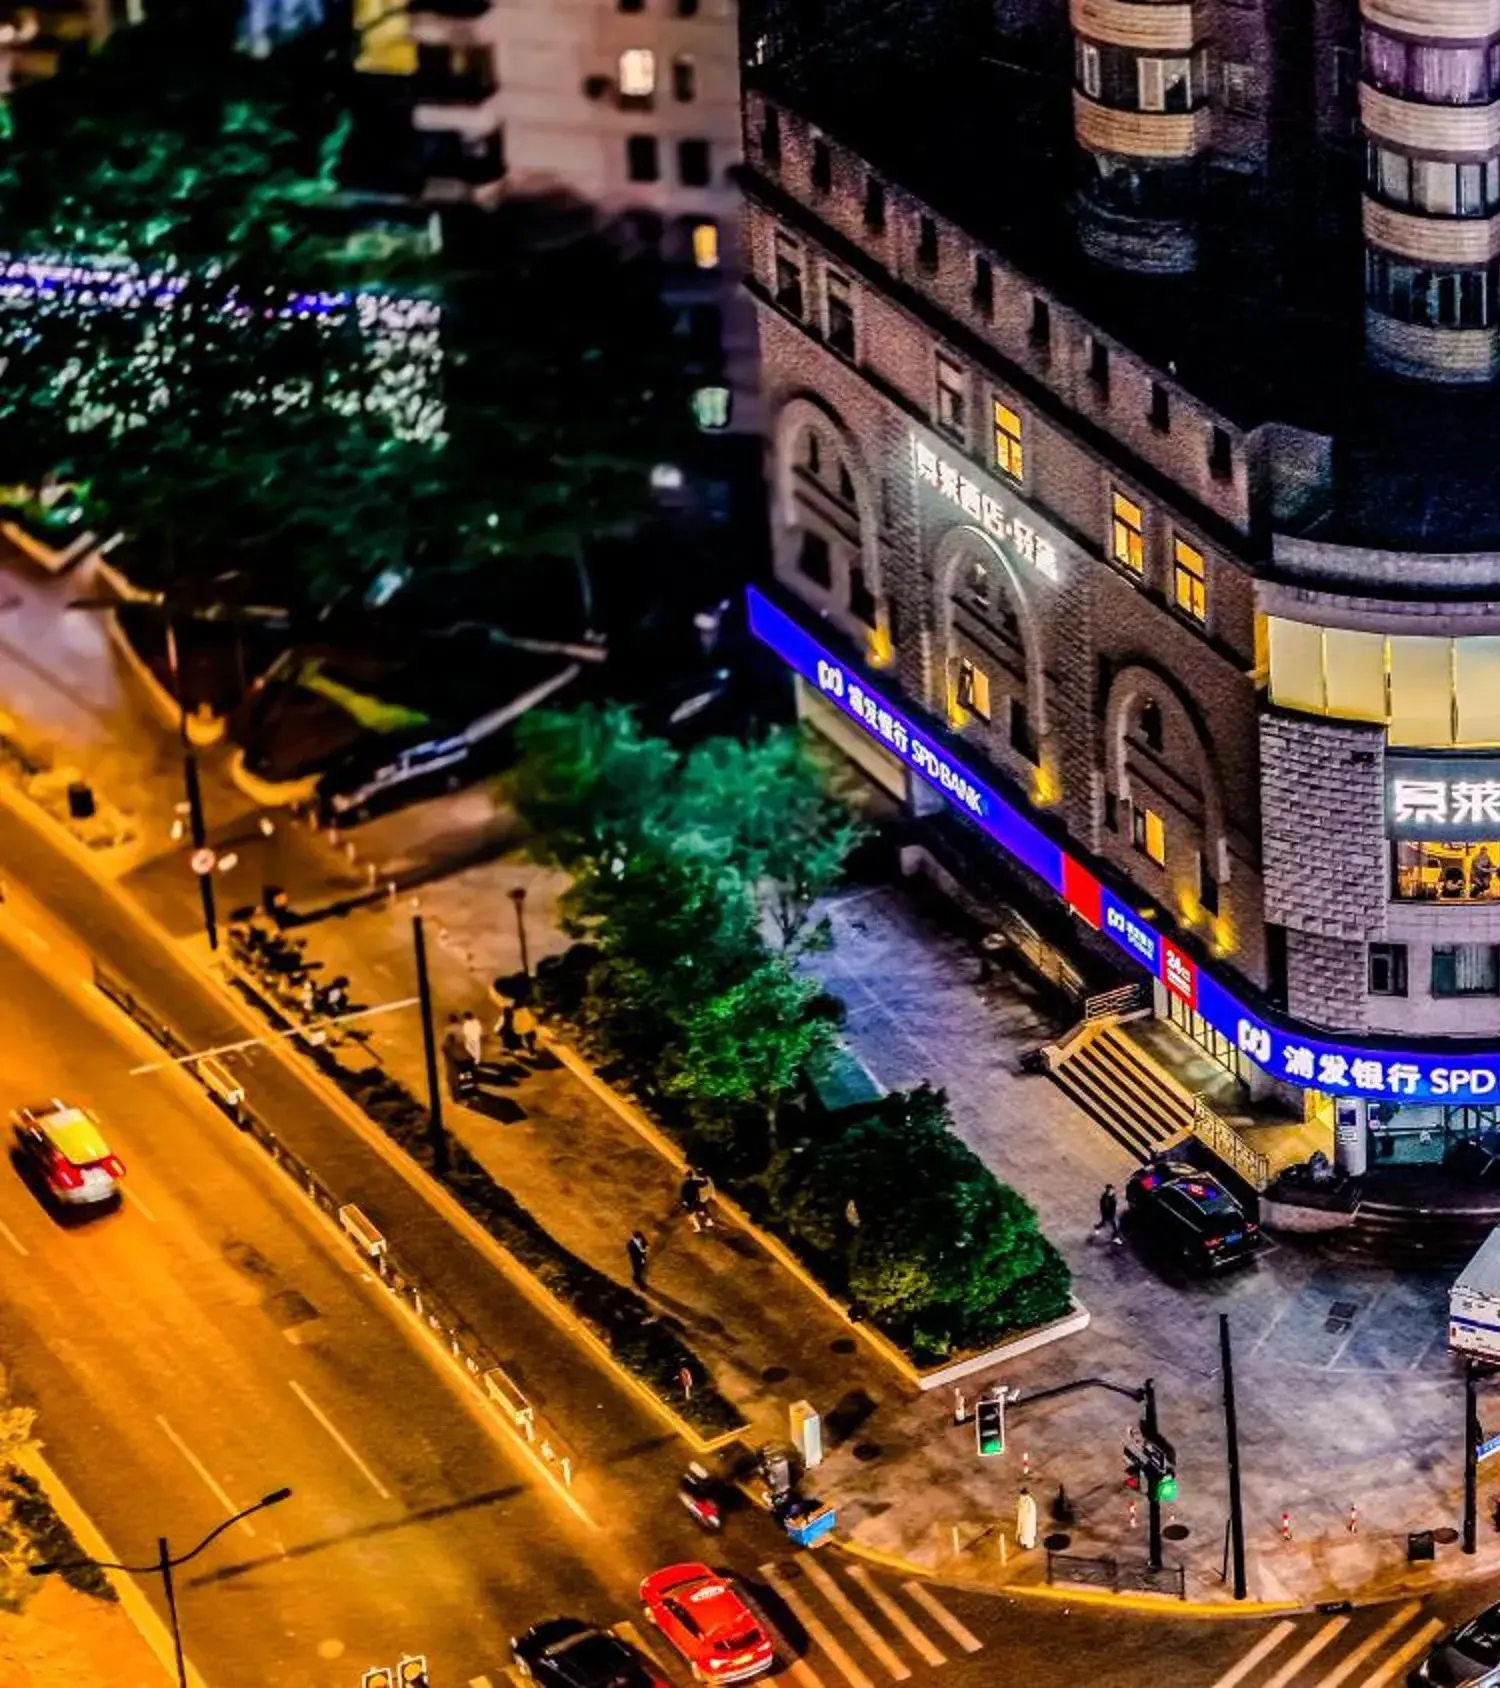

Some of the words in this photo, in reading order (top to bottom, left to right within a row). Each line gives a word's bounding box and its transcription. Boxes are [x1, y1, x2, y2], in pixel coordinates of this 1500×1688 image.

[911, 739, 940, 777] SPD
[939, 761, 984, 816] BANK
[1282, 1045, 1422, 1095] 浦发银行
[1429, 1067, 1497, 1095] SPD
